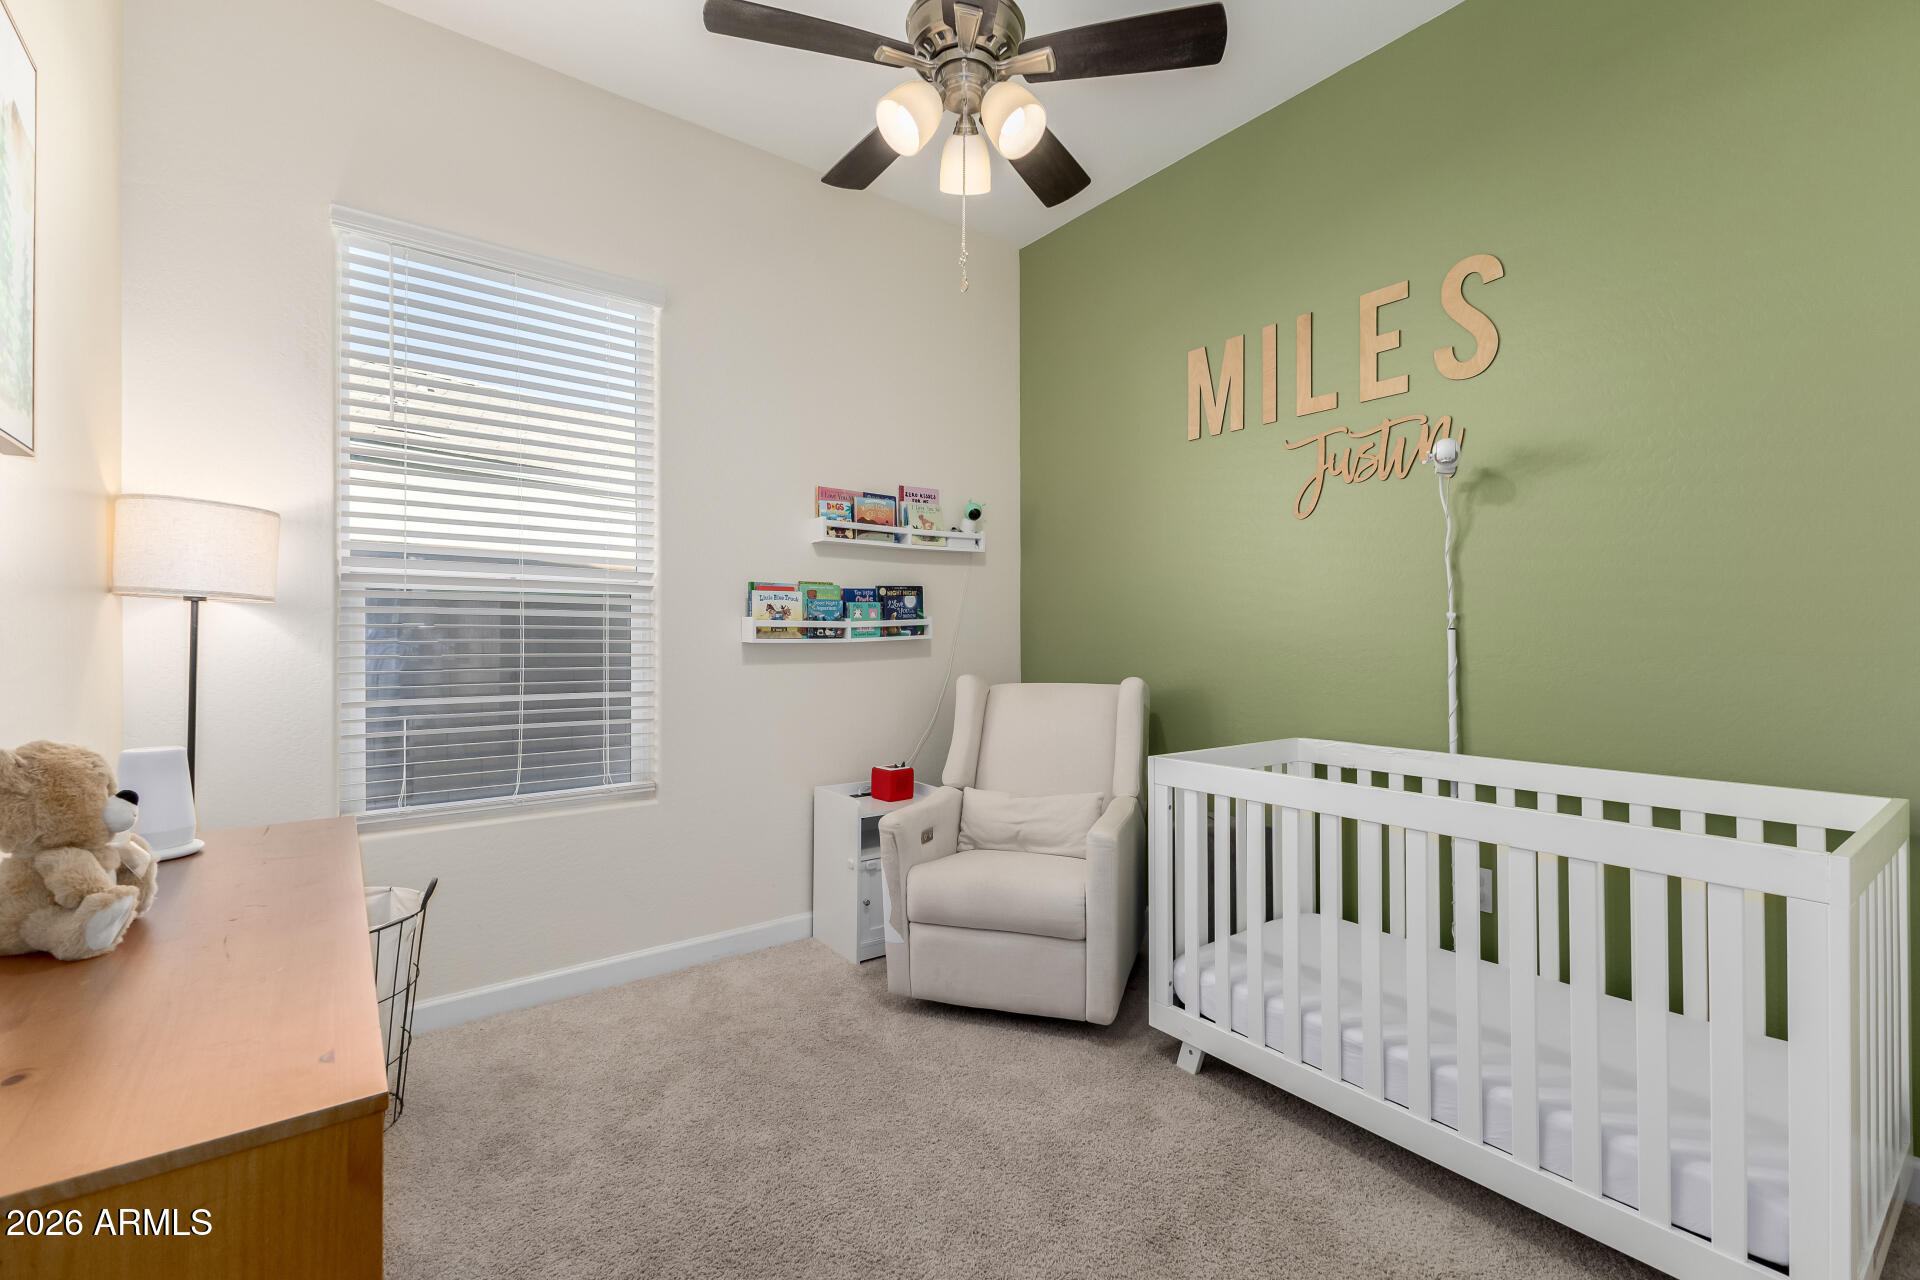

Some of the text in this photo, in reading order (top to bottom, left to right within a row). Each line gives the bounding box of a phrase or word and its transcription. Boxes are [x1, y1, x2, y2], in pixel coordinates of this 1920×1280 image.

[1188, 254, 1505, 441] MILES
[826, 502, 845, 511] DOGS
[1285, 414, 1465, 520] Justin
